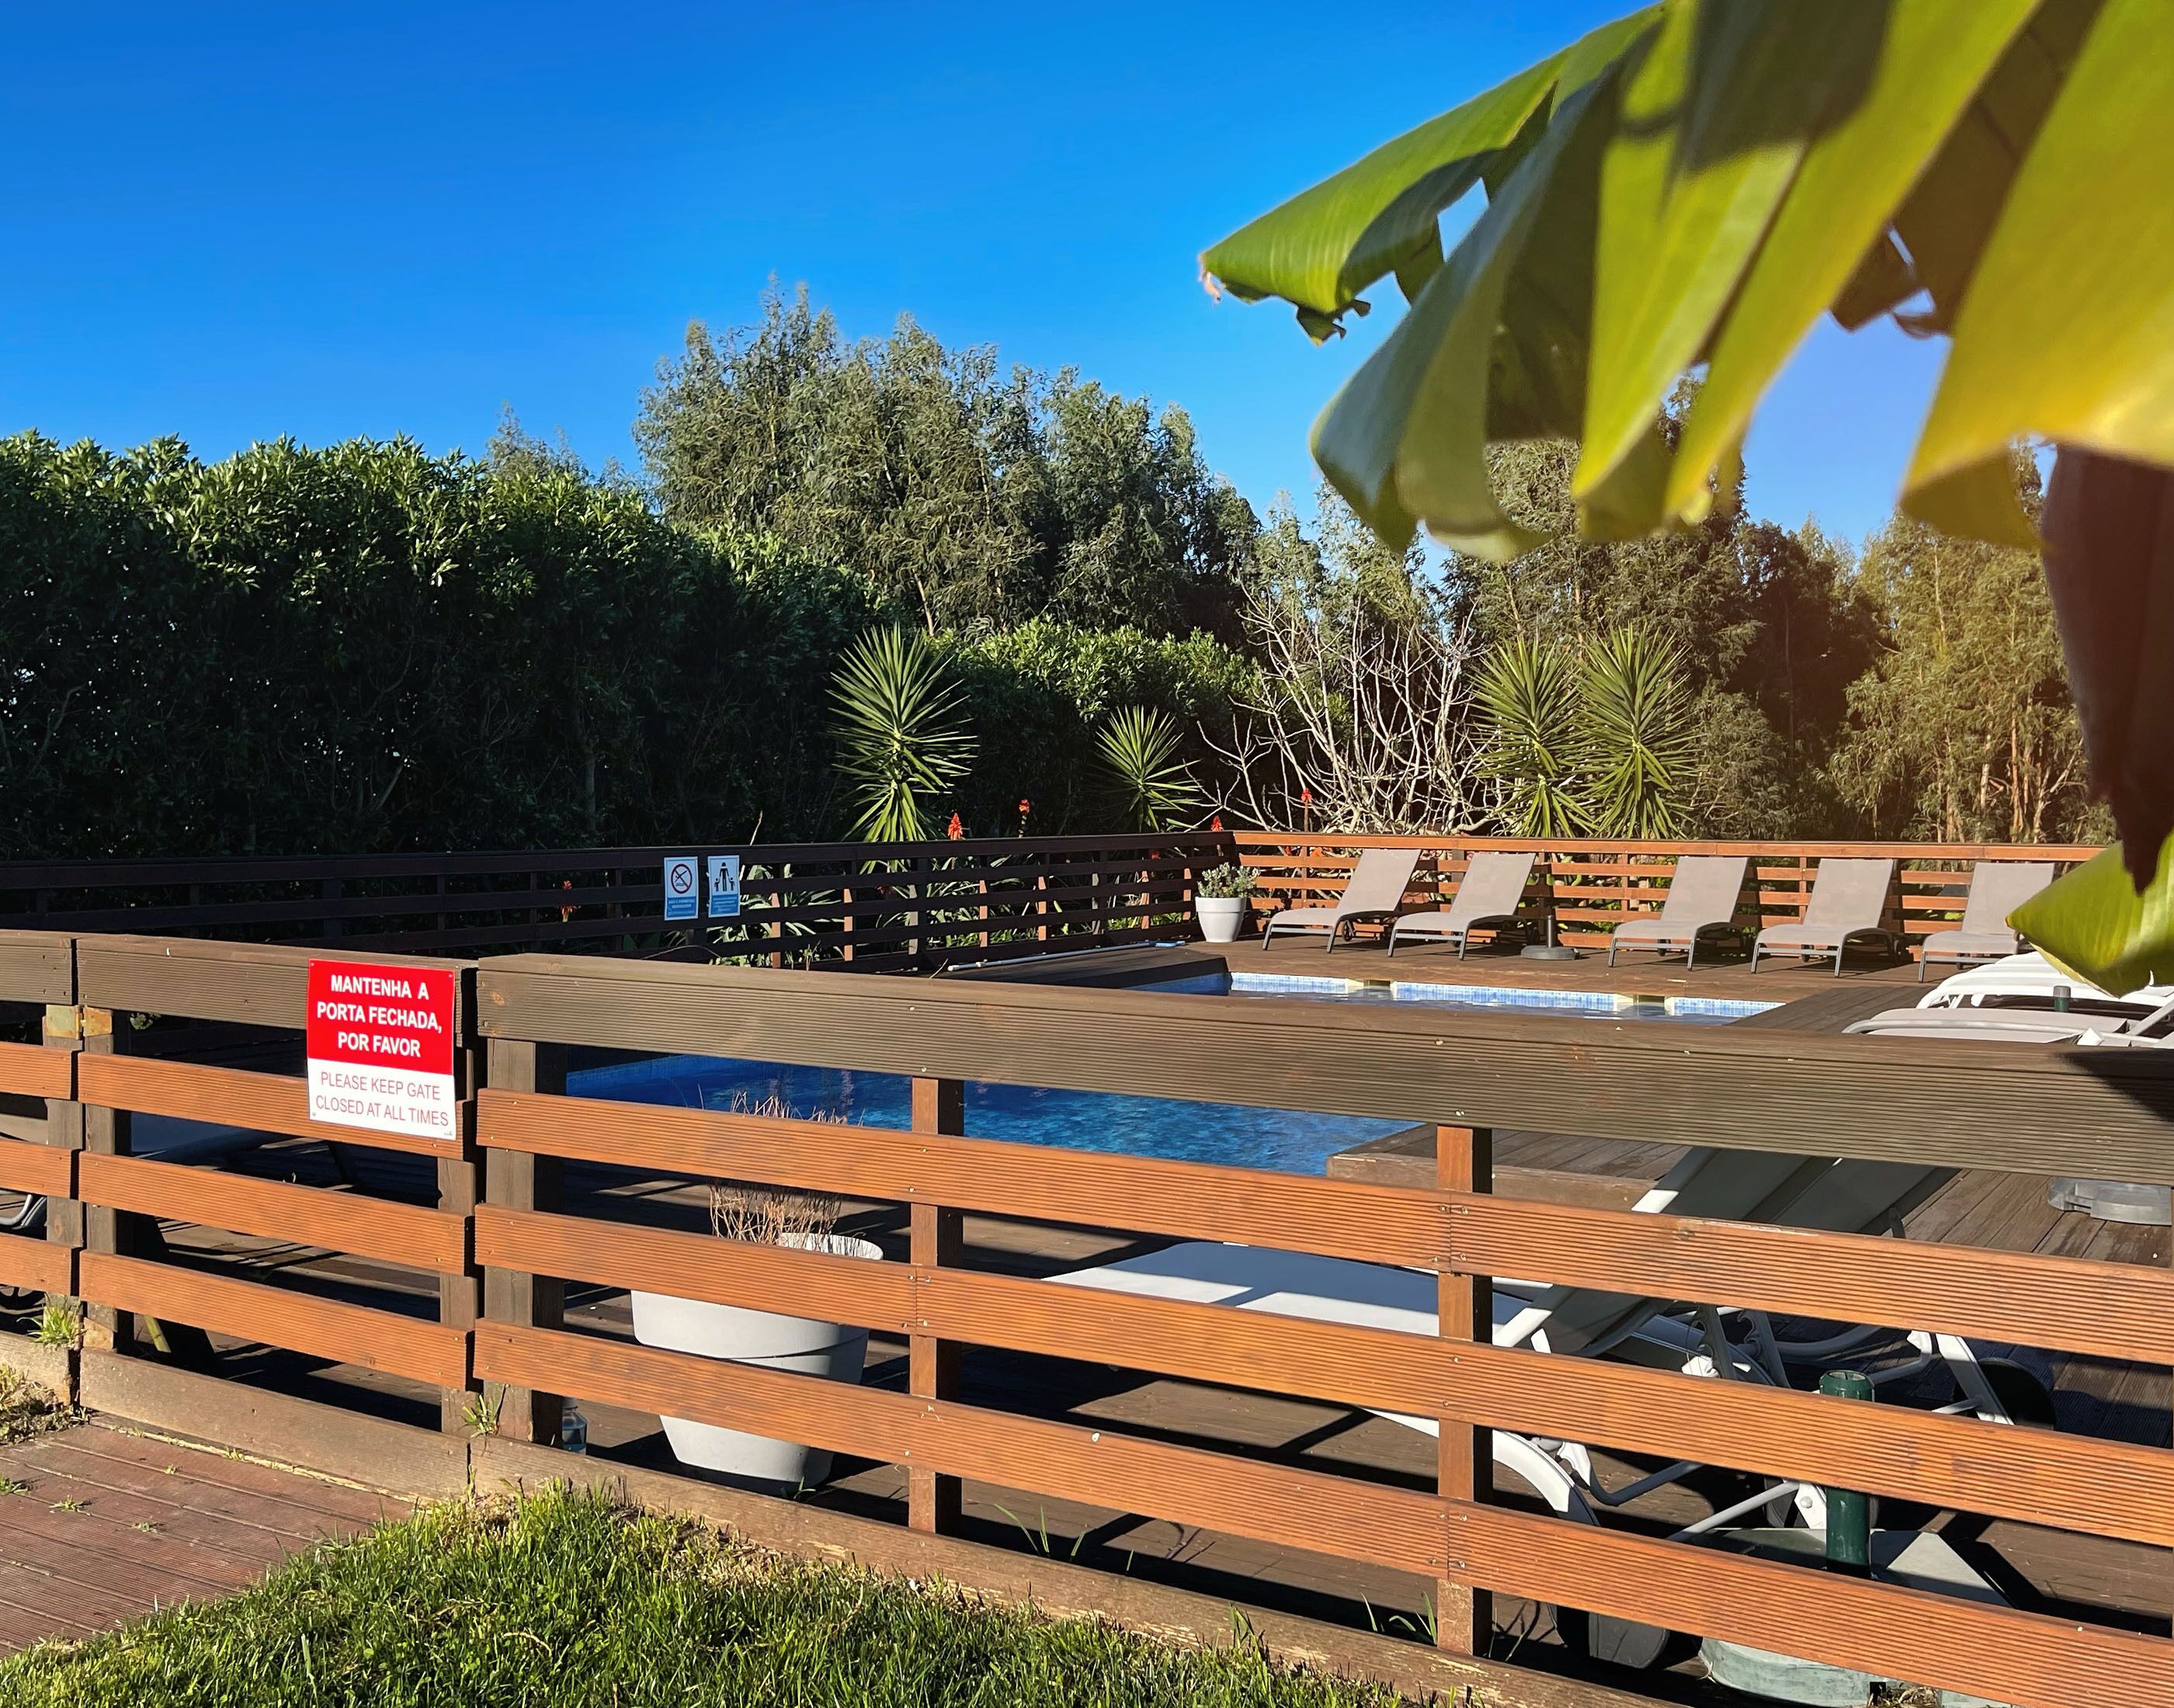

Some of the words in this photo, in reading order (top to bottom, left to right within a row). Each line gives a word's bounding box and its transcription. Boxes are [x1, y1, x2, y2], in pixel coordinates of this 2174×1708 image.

[331, 974, 412, 998] MANTENHA
[418, 982, 429, 1000] A
[317, 1001, 366, 1022] PORTA
[369, 1005, 443, 1034] FECHADA,
[338, 1031, 369, 1051] POR
[373, 1035, 421, 1057] FAVOR
[321, 1071, 367, 1091] PLEASE
[371, 1078, 404, 1095] KEEP
[407, 1082, 440, 1100] GATE
[316, 1095, 364, 1115] CLOSED
[366, 1102, 381, 1116] AT
[384, 1106, 405, 1121] ALL
[408, 1108, 449, 1127] TIMES
